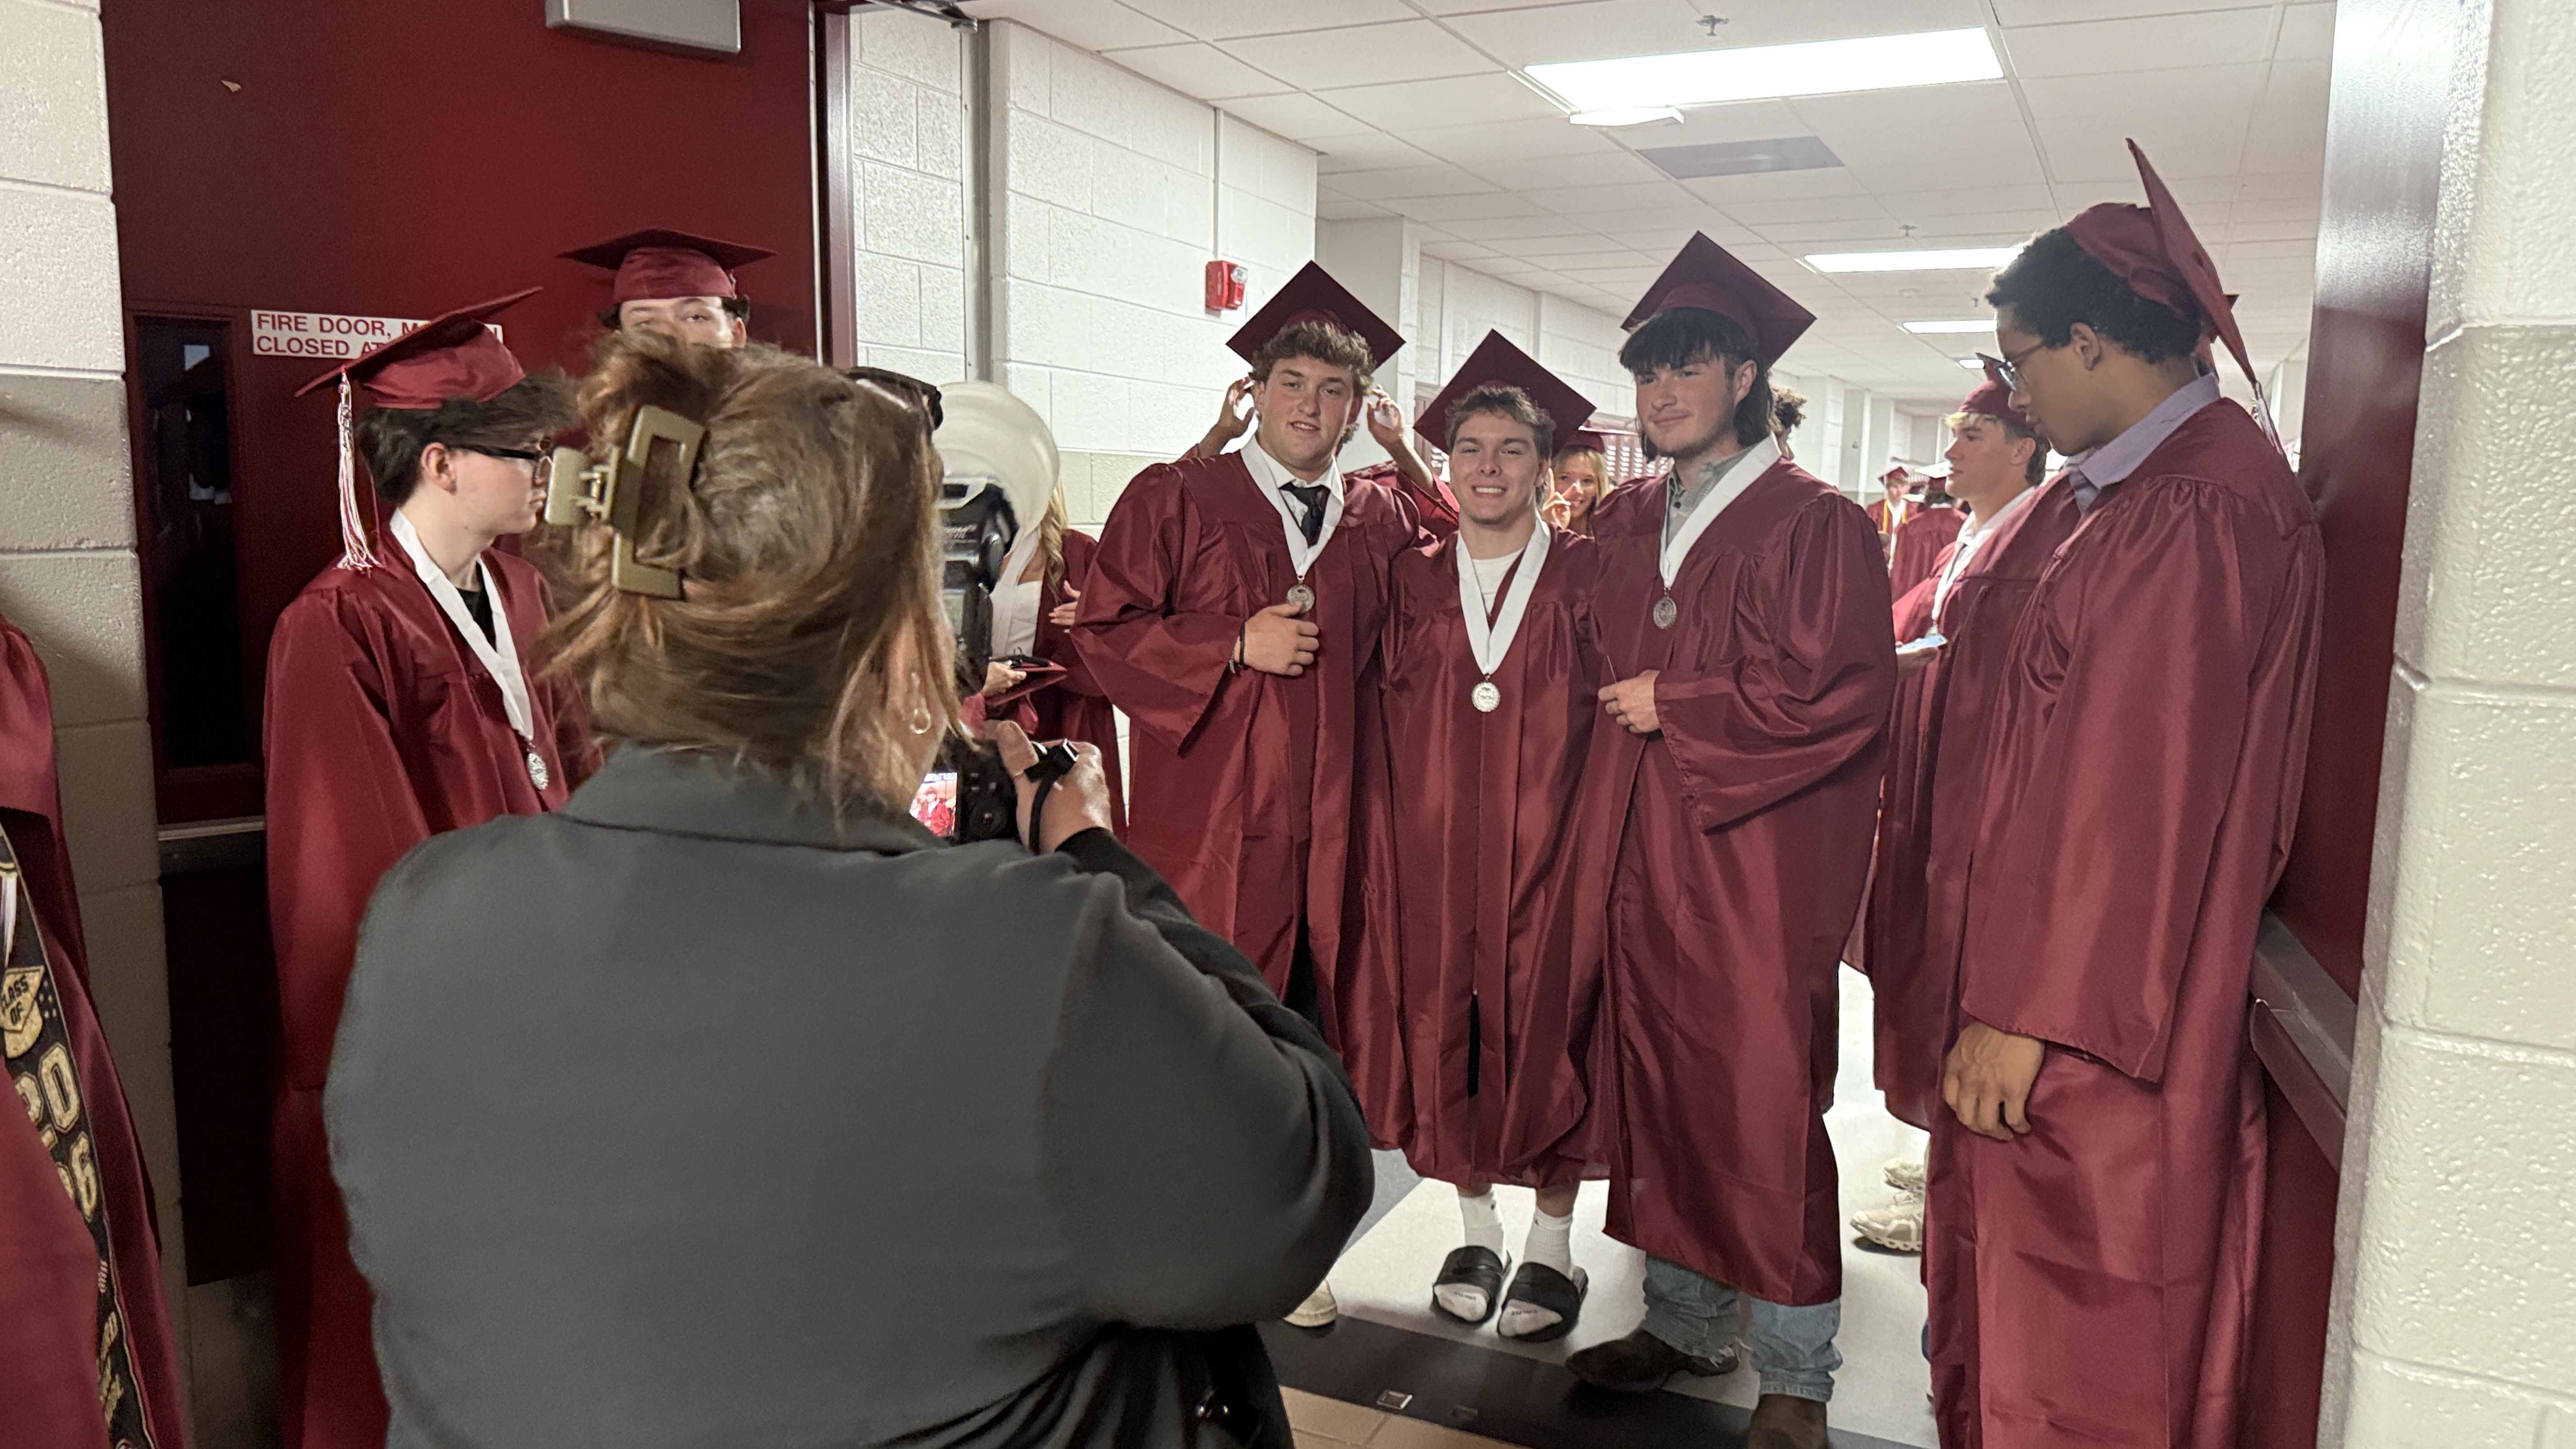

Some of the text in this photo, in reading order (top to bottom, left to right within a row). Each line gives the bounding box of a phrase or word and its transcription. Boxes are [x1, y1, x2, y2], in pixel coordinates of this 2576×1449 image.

[257, 313, 308, 332] FIRE
[319, 317, 391, 339] DOOR,
[257, 336, 350, 355] CLOSED
[10, 1001, 23, 1026] OF
